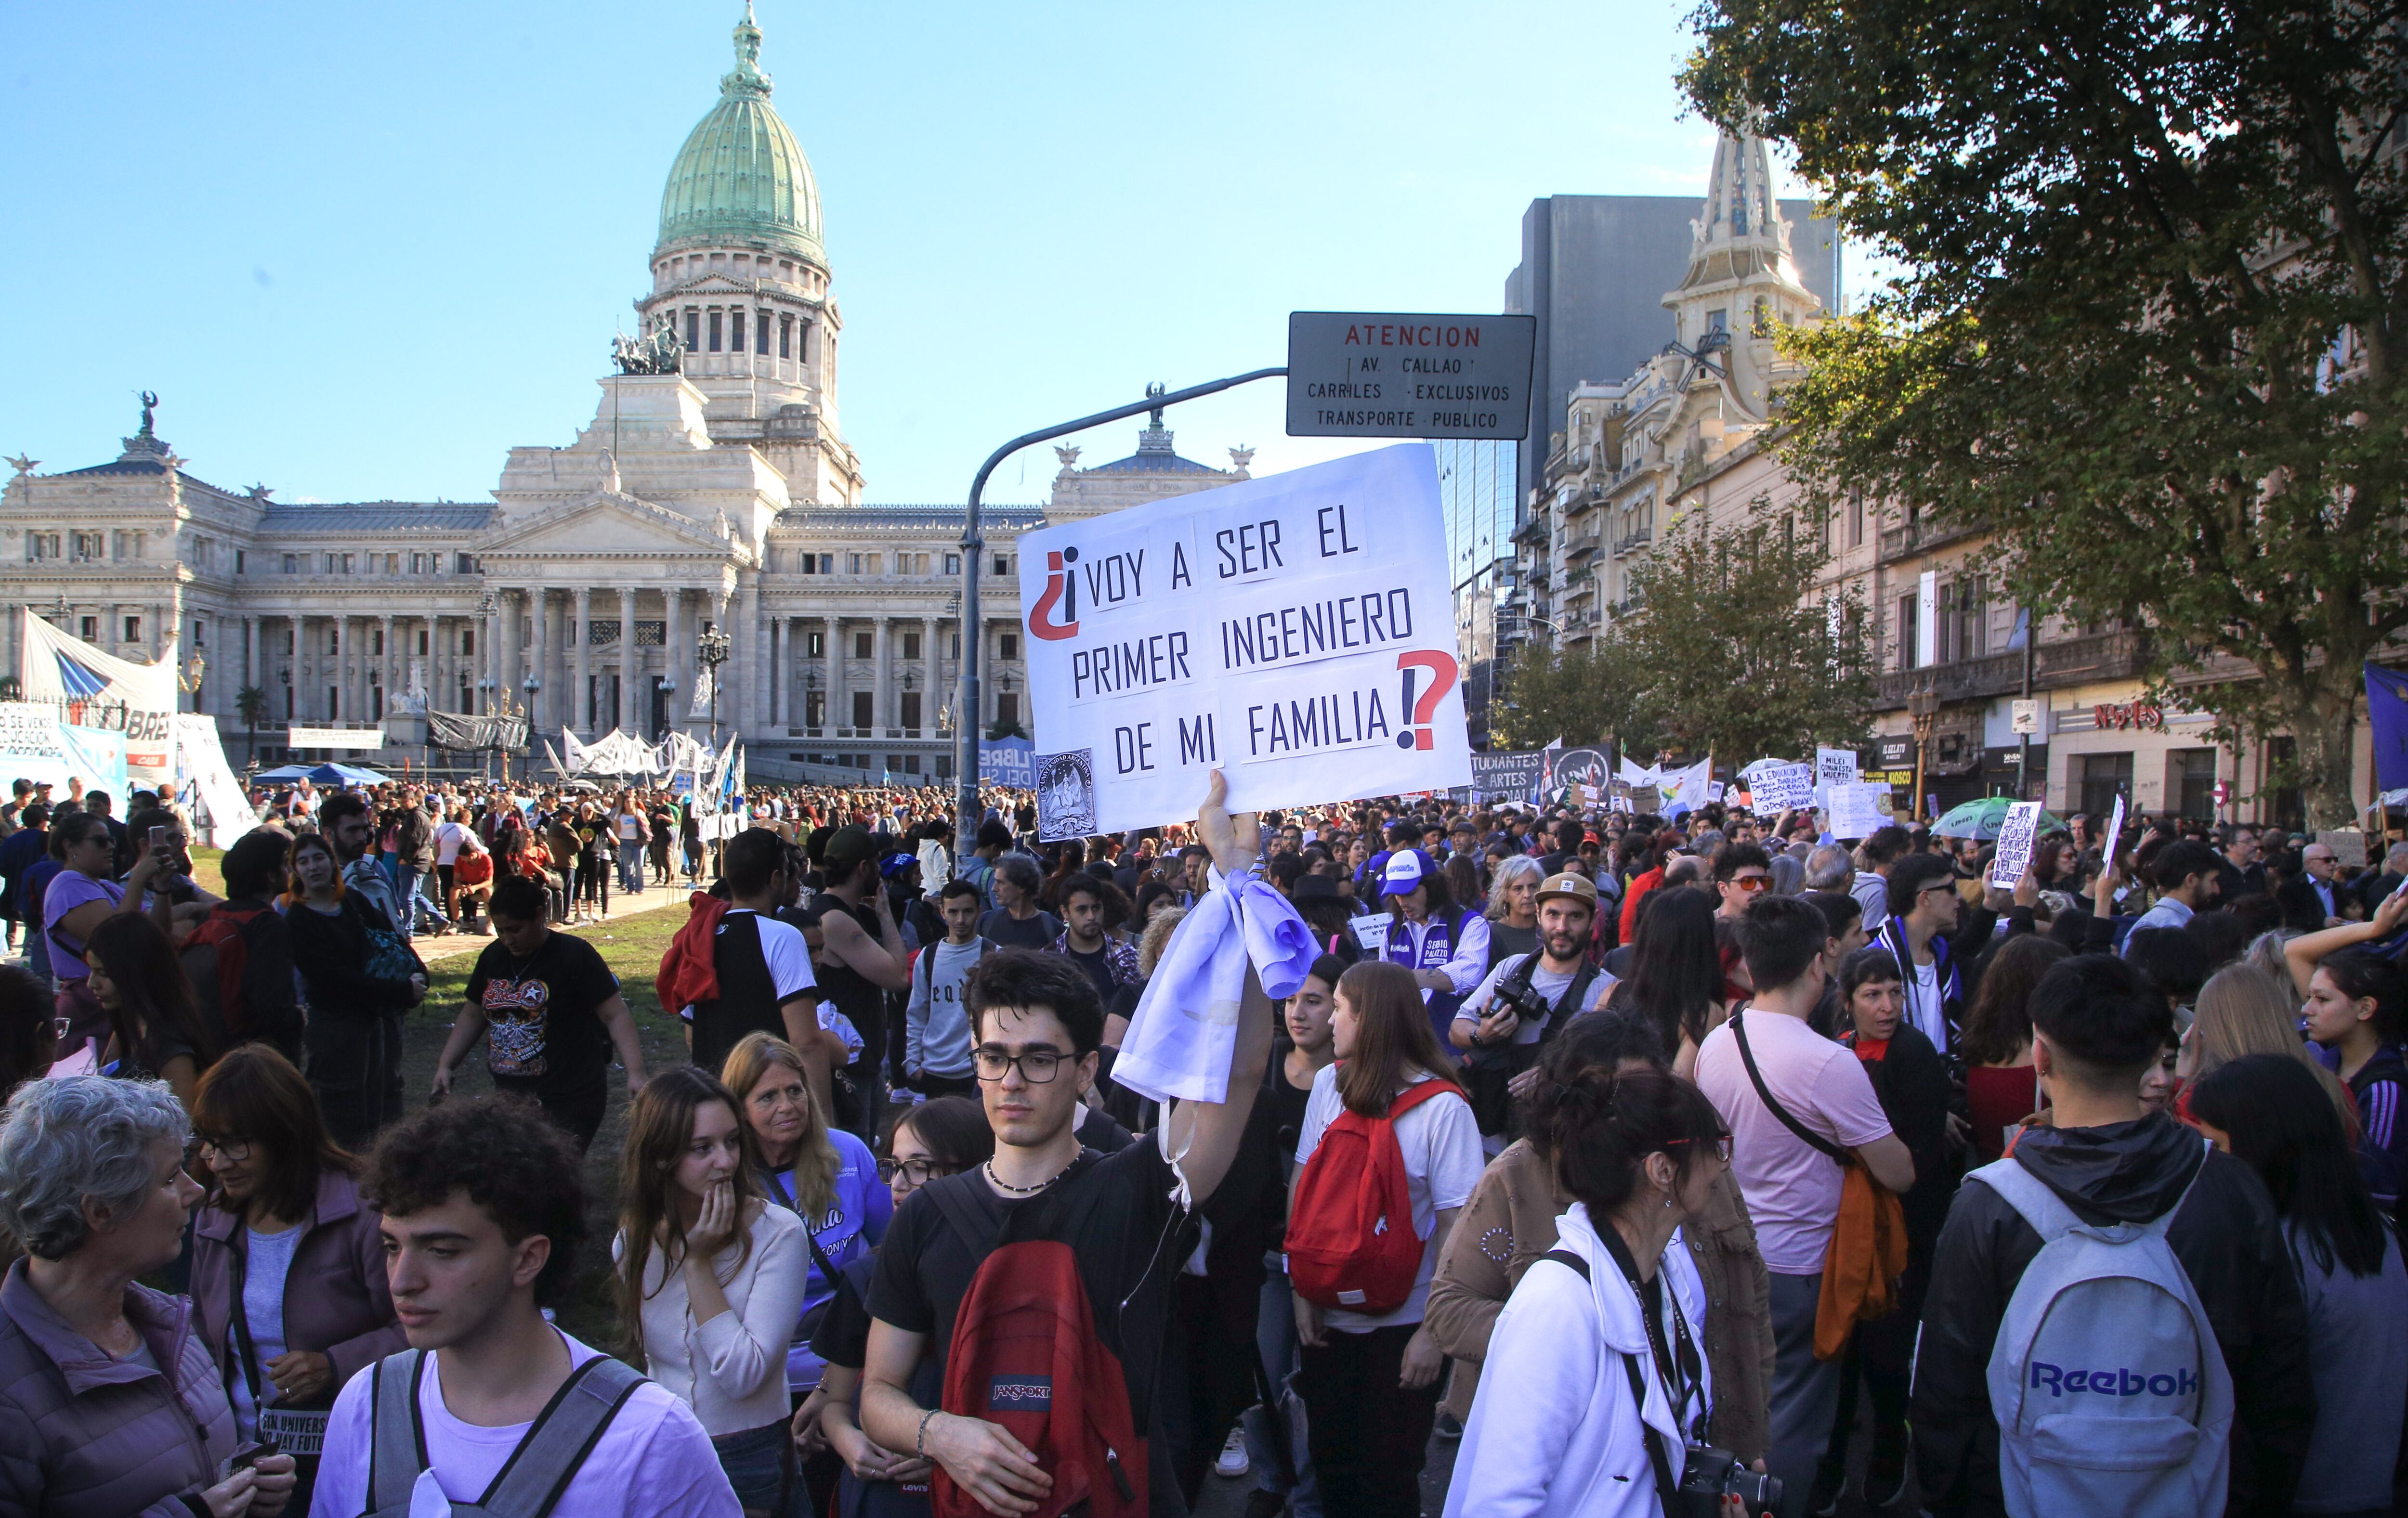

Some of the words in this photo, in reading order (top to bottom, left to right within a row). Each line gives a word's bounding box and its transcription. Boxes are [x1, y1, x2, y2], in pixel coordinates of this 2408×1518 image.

[1345, 325, 1479, 347] ATENCION
[1361, 358, 1380, 372] AV.
[1402, 358, 1461, 373] CALLAO
[1308, 384, 1381, 399] CARRILES
[1416, 385, 1509, 401] EXCLUSIVOS
[1318, 411, 1414, 426] TRANSPORTE
[1433, 413, 1497, 428] PUBLICO
[1172, 542, 1191, 590] A
[1216, 520, 1283, 578] SER
[1318, 505, 1358, 557] EL
[1073, 632, 1190, 698] PRIMER
[1222, 588, 1412, 669] INGENIERO
[1115, 723, 1154, 774] DE
[1179, 714, 1216, 765] MI
[1471, 753, 1540, 771] TUDIANTES
[1490, 772, 1527, 788] ARTES
[1748, 773, 1763, 783] LA
[1889, 771, 1911, 785] KIOSCO
[2031, 1361, 2199, 1398] Reebok
[281, 1416, 327, 1434] UNIVERS
